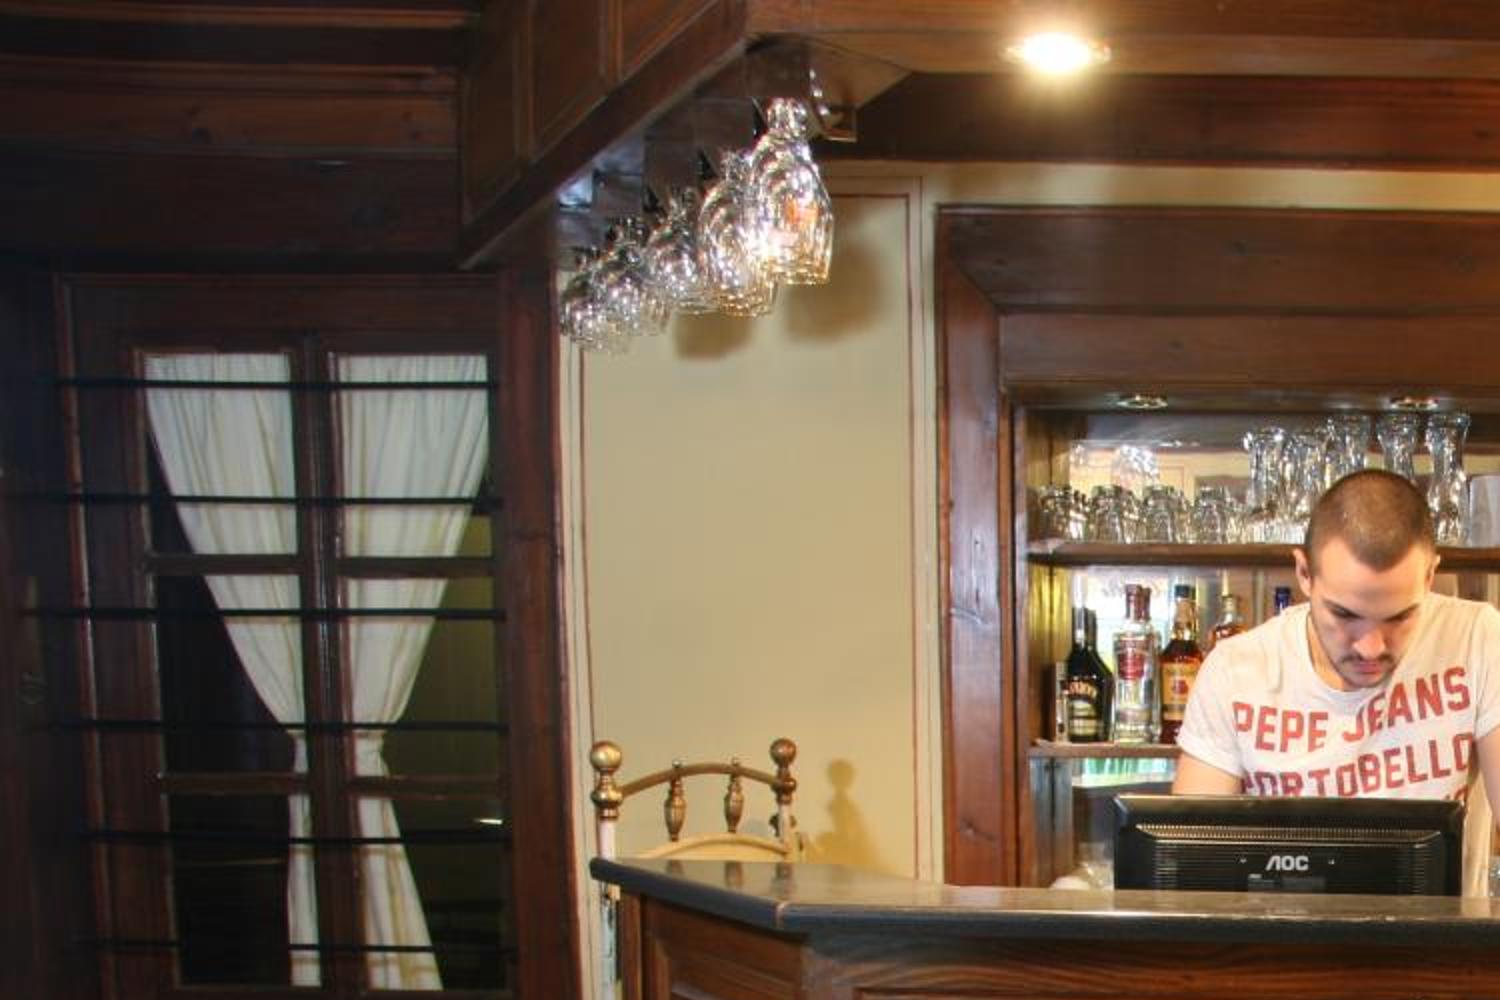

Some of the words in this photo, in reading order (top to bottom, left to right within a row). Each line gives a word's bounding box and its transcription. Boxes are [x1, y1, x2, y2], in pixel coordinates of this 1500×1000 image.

[1232, 701, 1328, 752] PEPE
[1342, 666, 1470, 742] JEANS
[1265, 855, 1309, 871] AOC
